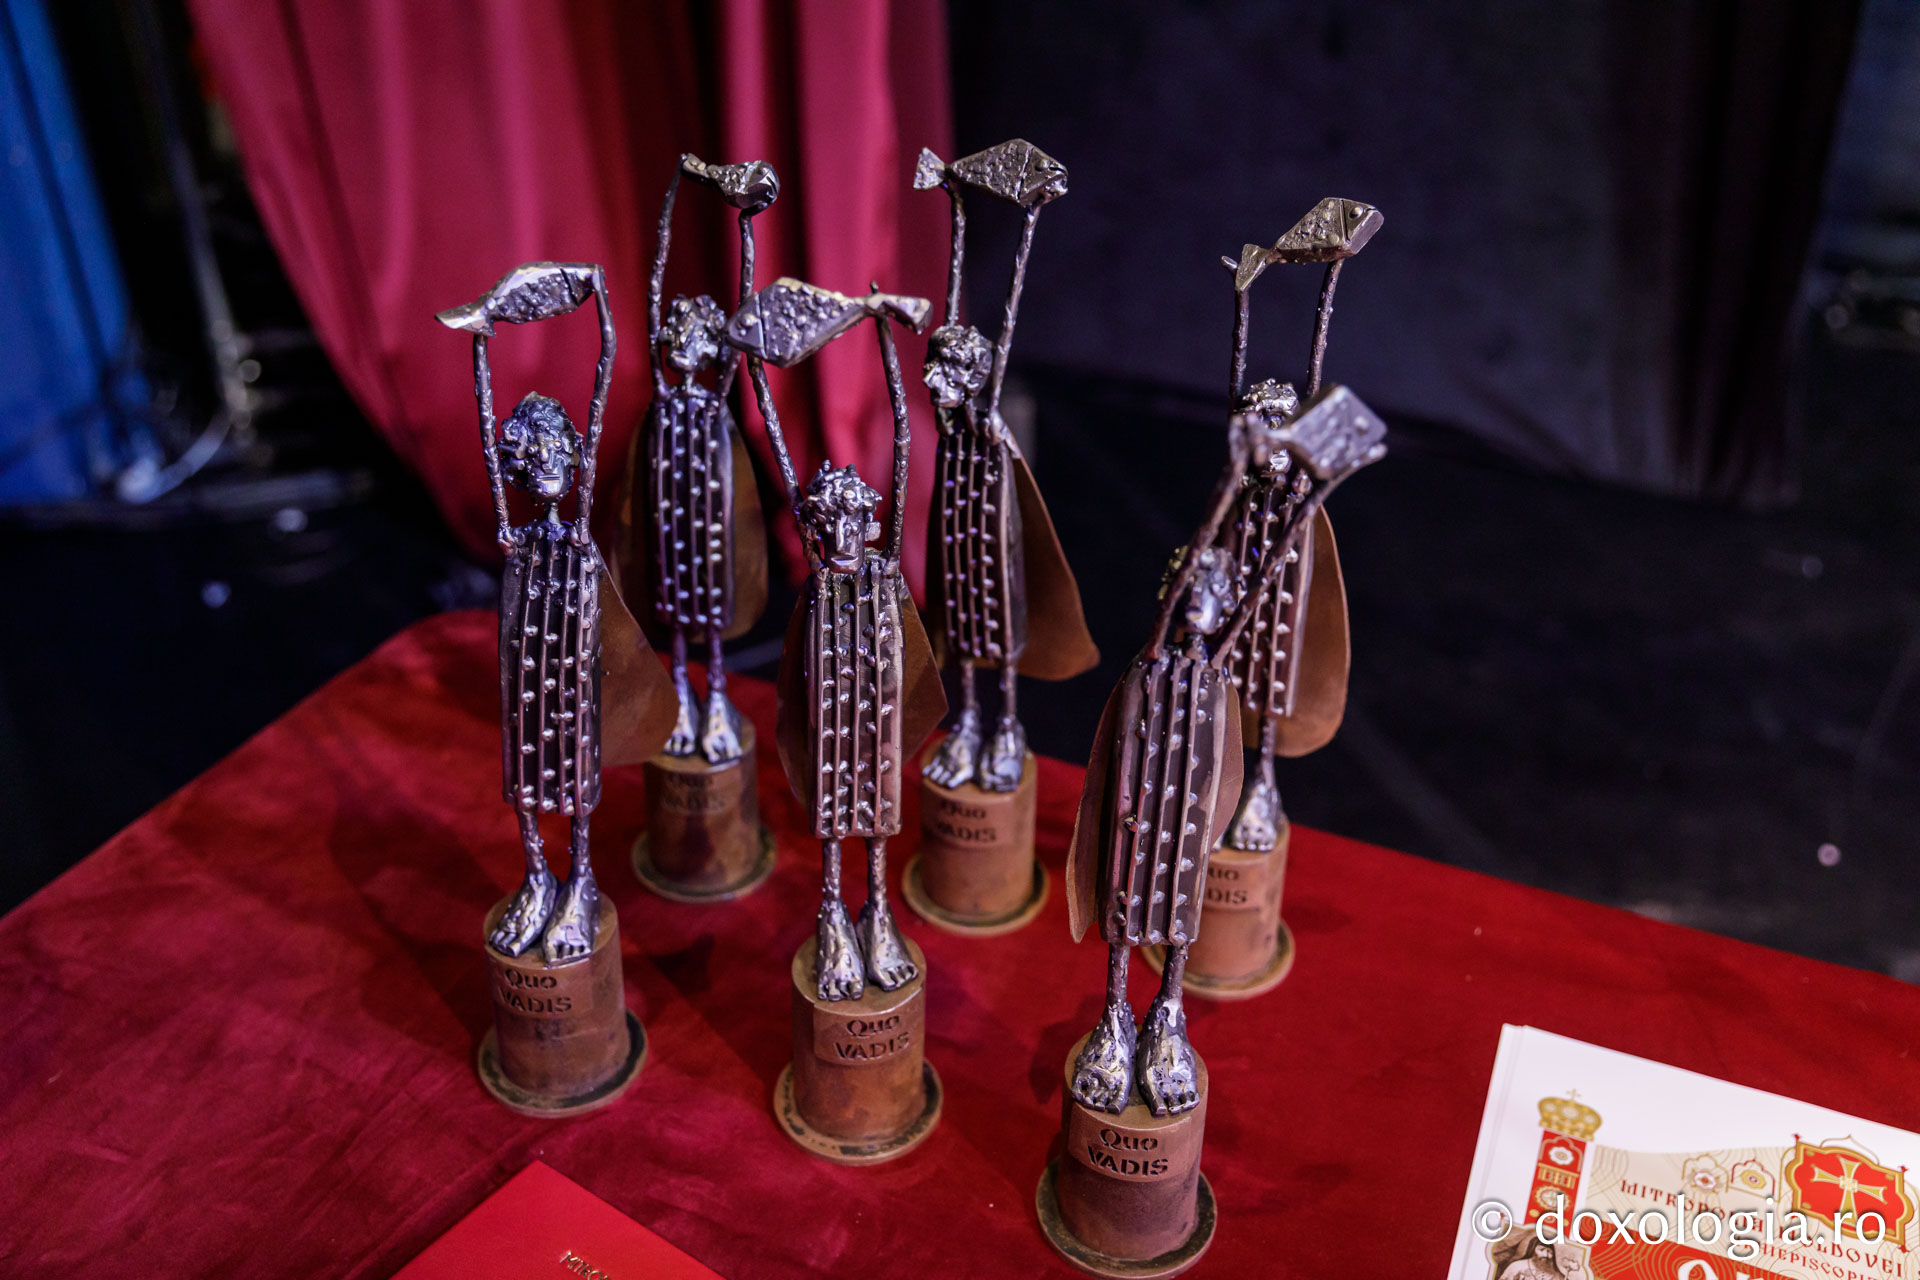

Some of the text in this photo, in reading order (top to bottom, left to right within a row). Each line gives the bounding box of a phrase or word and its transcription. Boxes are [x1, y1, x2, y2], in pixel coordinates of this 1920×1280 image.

[1207, 867, 1239, 880] uo
[1207, 888, 1248, 904] DIS
[505, 968, 557, 989] Quo
[499, 986, 572, 1013] VADIS
[846, 1015, 900, 1037] Quo
[834, 1031, 910, 1059] VADIS
[1099, 1128, 1158, 1151] Quo
[1087, 1144, 1169, 1176] VADIS
